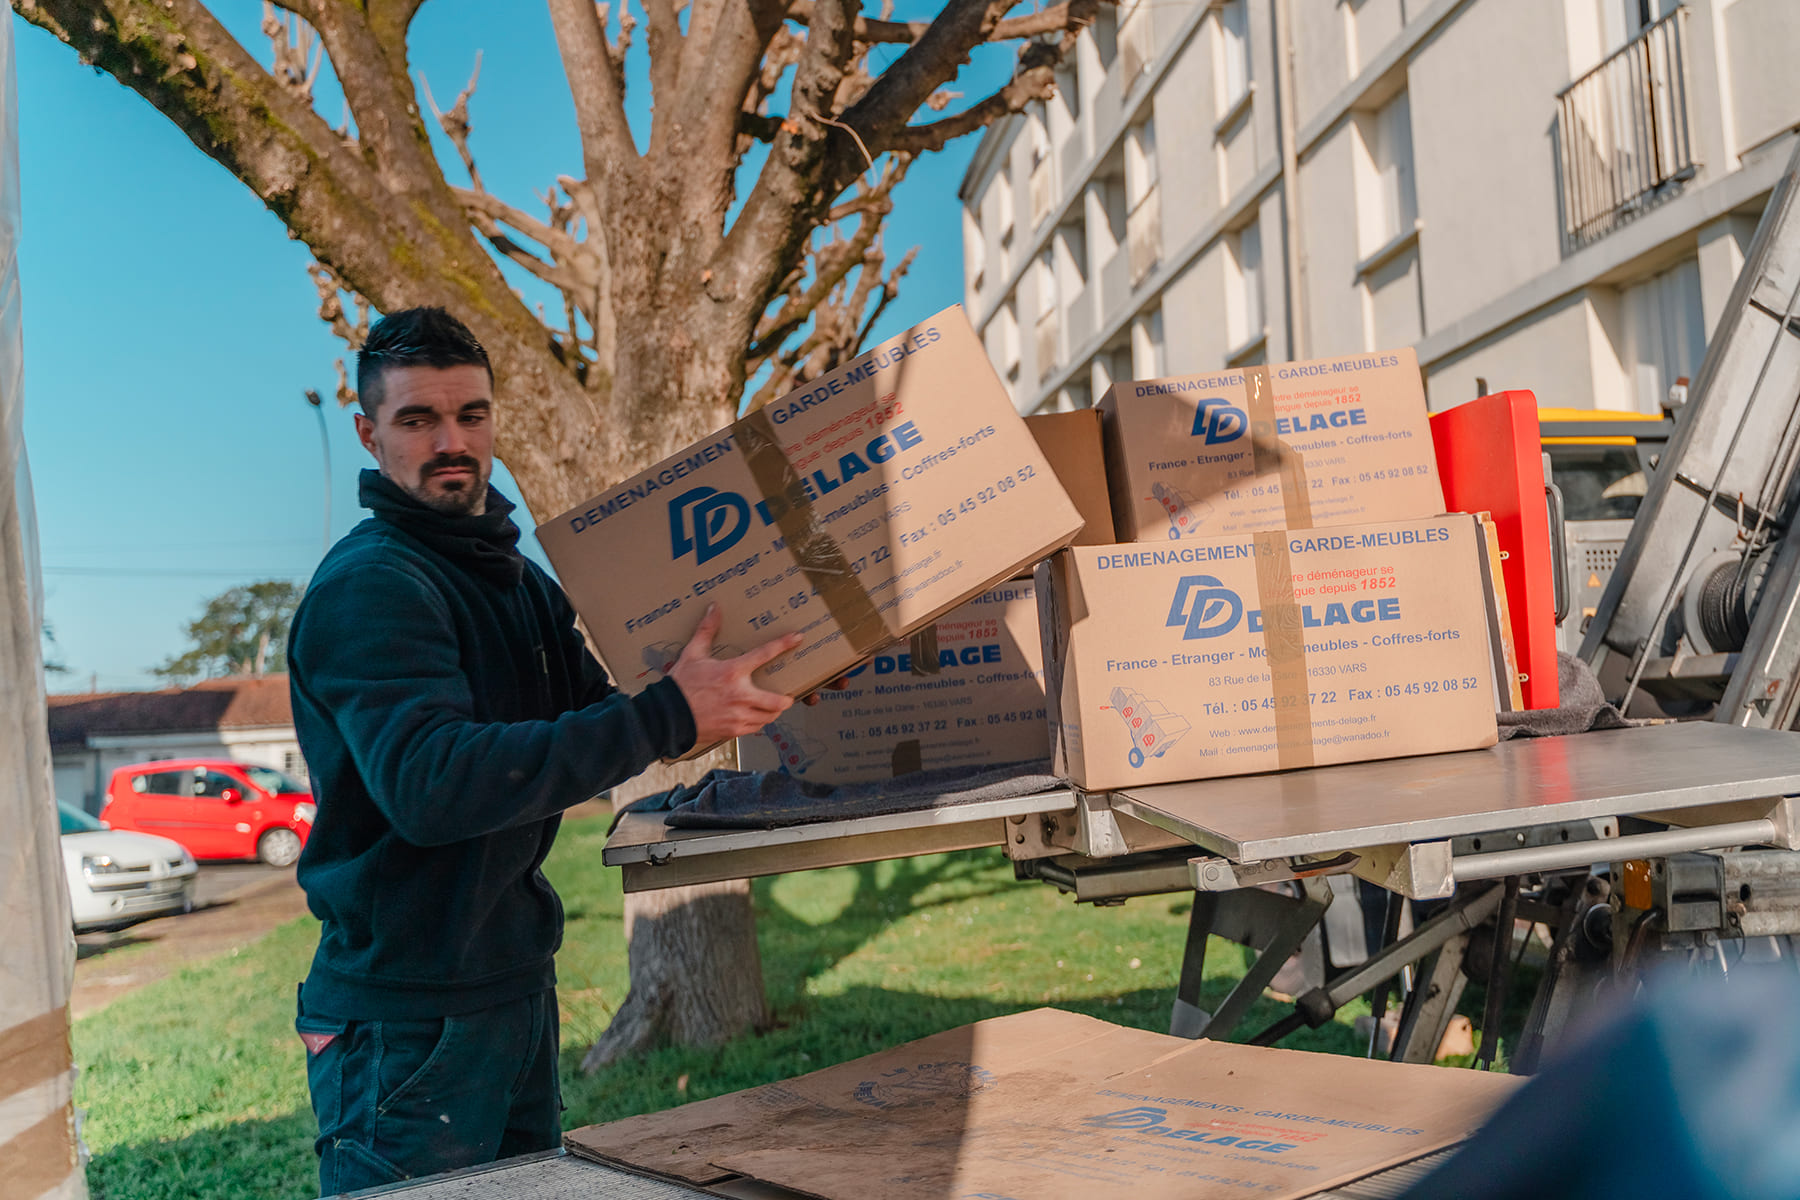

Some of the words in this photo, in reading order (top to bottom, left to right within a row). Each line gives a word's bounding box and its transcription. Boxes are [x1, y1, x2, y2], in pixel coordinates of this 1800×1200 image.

[1136, 374, 1247, 398] DEMENAGEMEN
[1278, 356, 1399, 380] GARDE-MEUBLES
[881, 391, 897, 406] se
[1303, 399, 1332, 409] depuis
[1334, 393, 1361, 405] 1852
[570, 434, 735, 534] DEMENAGEMEN
[772, 327, 941, 424] GARDE-MEUBLES
[822, 427, 864, 452] depuis
[865, 402, 904, 429] 1852
[1148, 459, 1187, 471] France
[1197, 452, 1245, 465] Etranger
[1346, 430, 1413, 445] Coffres-forts
[1251, 486, 1265, 497] 05
[1267, 484, 1280, 495] 45
[1311, 478, 1324, 489] 22
[1331, 475, 1351, 487] Fax
[1359, 472, 1371, 482] 05
[1374, 470, 1385, 480] 45
[1388, 468, 1400, 478] 92
[1402, 466, 1414, 476] 08
[1416, 464, 1428, 474] 52
[624, 598, 682, 634] France
[692, 552, 760, 597] Etranger
[772, 482, 890, 552] M-meubles
[901, 425, 996, 480] Coffres-forts
[788, 590, 809, 610] 05
[850, 556, 867, 576] 37
[870, 545, 891, 565] 22
[899, 526, 928, 548] Fax
[937, 508, 957, 527] 05
[959, 497, 976, 514] 45
[977, 486, 997, 504] 92
[997, 476, 1016, 493] 08
[1017, 464, 1036, 482] 52
[1289, 527, 1450, 554] GARDE-MEUBLES
[760, 572, 784, 590] Rue
[785, 564, 800, 578] de
[1307, 565, 1378, 583] déménageur
[1380, 566, 1394, 575] se
[1319, 581, 1357, 596] depuis
[1360, 576, 1397, 591] 1852
[1247, 597, 1401, 633] DLAGE
[968, 627, 998, 640] 1852
[874, 644, 1002, 674] DEAGE
[1106, 658, 1158, 672] France
[1172, 651, 1235, 665] Etranger
[1371, 628, 1460, 647] Coffres-forts
[819, 689, 864, 701] tranger
[875, 677, 966, 695] Monte-meubles
[976, 669, 1045, 684] Coffres-fort
[1208, 676, 1221, 688] 83
[1223, 675, 1244, 686] Rue
[1246, 673, 1259, 683] de
[1261, 671, 1271, 682] la
[1307, 665, 1336, 677] 16330
[1338, 662, 1368, 674] VARS
[1203, 701, 1229, 715] Tél.
[1241, 698, 1258, 711] 05
[1261, 697, 1277, 709] 45
[1321, 691, 1337, 703] 22
[1348, 688, 1373, 701] Fax
[1385, 685, 1400, 697] 05
[1404, 683, 1420, 695] 45
[1423, 681, 1439, 693] 92
[1443, 679, 1458, 691] 08
[1462, 677, 1478, 689] 52
[869, 727, 882, 737] 05
[885, 725, 898, 735] 45
[901, 723, 914, 734] 92
[918, 721, 930, 731] 37
[935, 720, 947, 730] 22
[957, 717, 977, 728] Fax
[987, 714, 1000, 724] 05
[1003, 712, 1017, 722] 45
[1020, 710, 1033, 720] 92
[1209, 728, 1231, 738] Web
[1199, 747, 1218, 757] Mail
[1254, 1110, 1425, 1136] GARDE-MEUBLES
[1137, 1125, 1299, 1153] DELAGE
